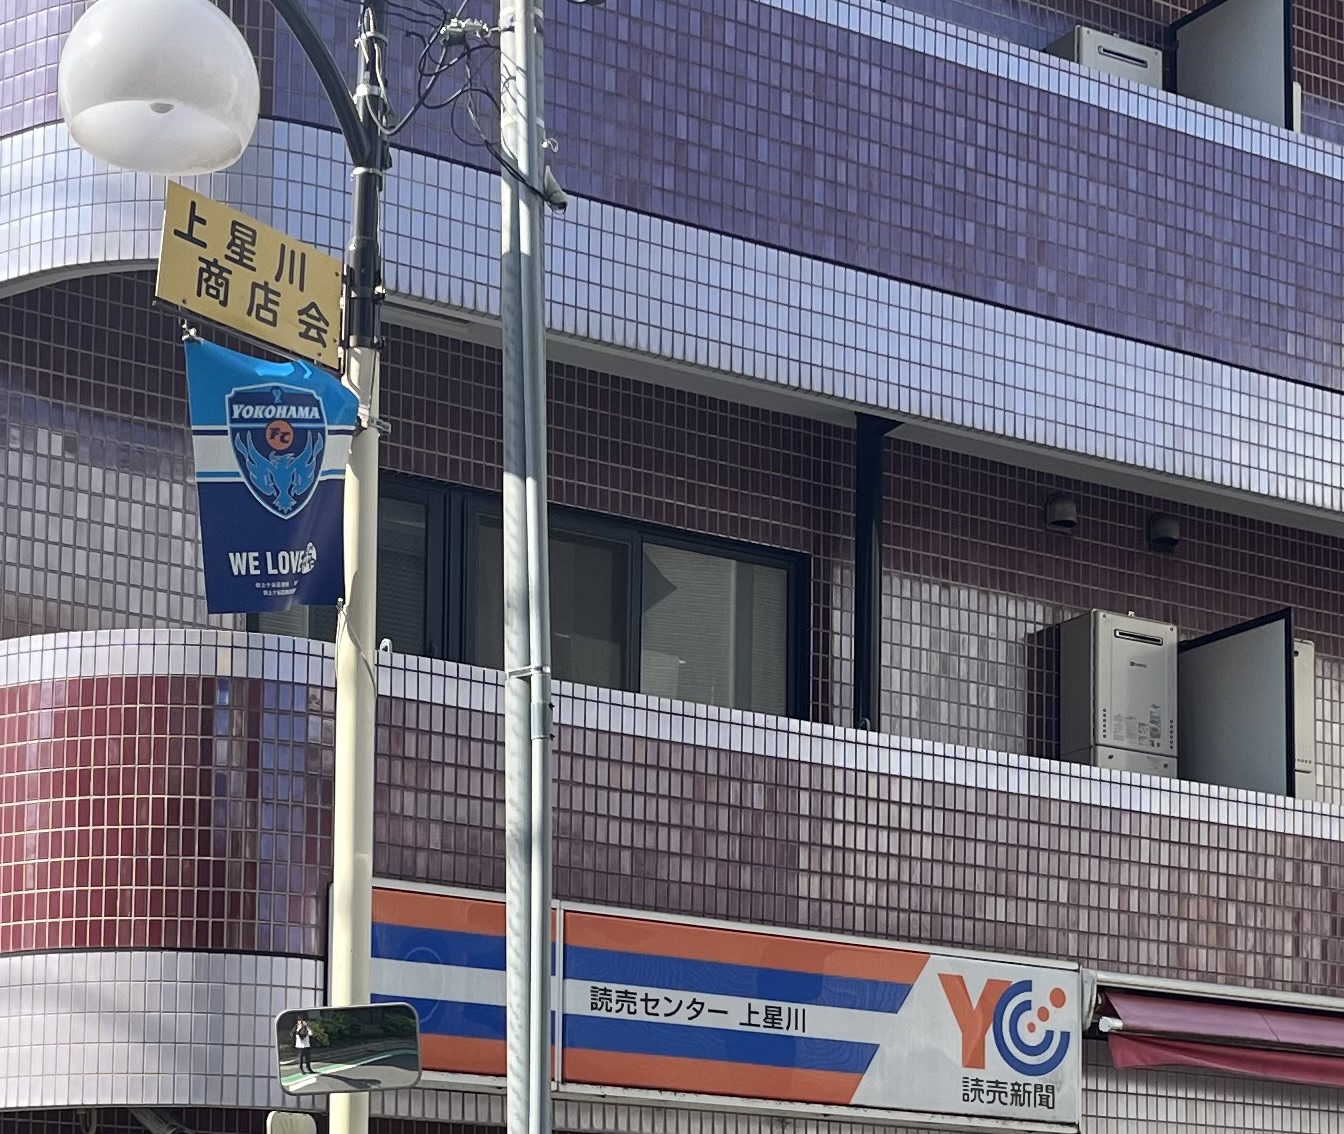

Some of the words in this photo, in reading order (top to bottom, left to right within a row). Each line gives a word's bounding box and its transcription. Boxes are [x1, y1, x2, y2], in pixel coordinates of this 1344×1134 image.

[173, 200, 307, 292] 上星川
[196, 257, 330, 348] 商店会
[232, 404, 320, 419] YOKOHAMA
[269, 427, 291, 444] FC
[228, 552, 261, 576] WE
[590, 986, 728, 1021] 読売センター
[739, 1002, 806, 1033] 上星川
[962, 1077, 1055, 1110] 読売新聞
